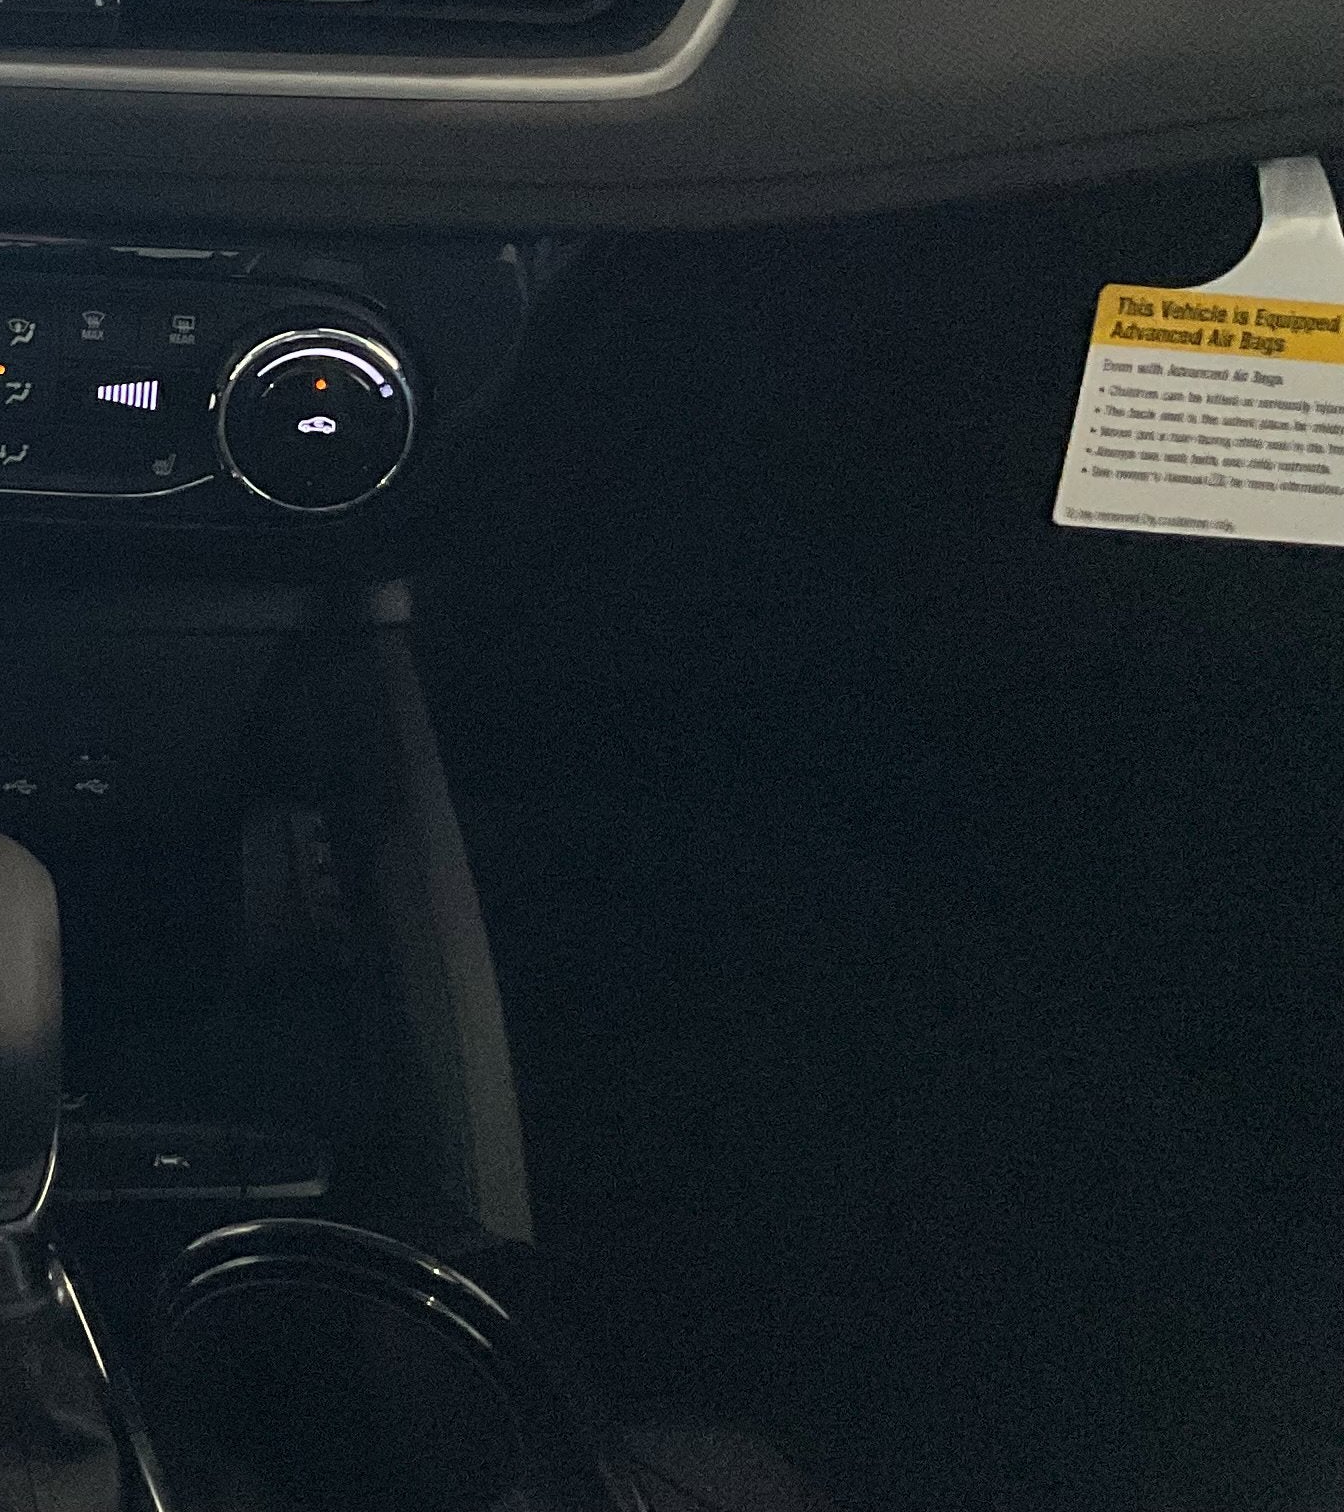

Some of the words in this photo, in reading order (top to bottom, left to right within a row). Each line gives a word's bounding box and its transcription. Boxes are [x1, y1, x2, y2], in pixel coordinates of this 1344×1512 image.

[1118, 296, 1154, 317] This
[1161, 299, 1228, 324] Vehicle
[1232, 304, 1249, 326] is
[1255, 308, 1342, 334] Equipped
[1110, 320, 1203, 346] Advanced
[1207, 328, 1235, 348] Air
[1238, 330, 1286, 357] Bags
